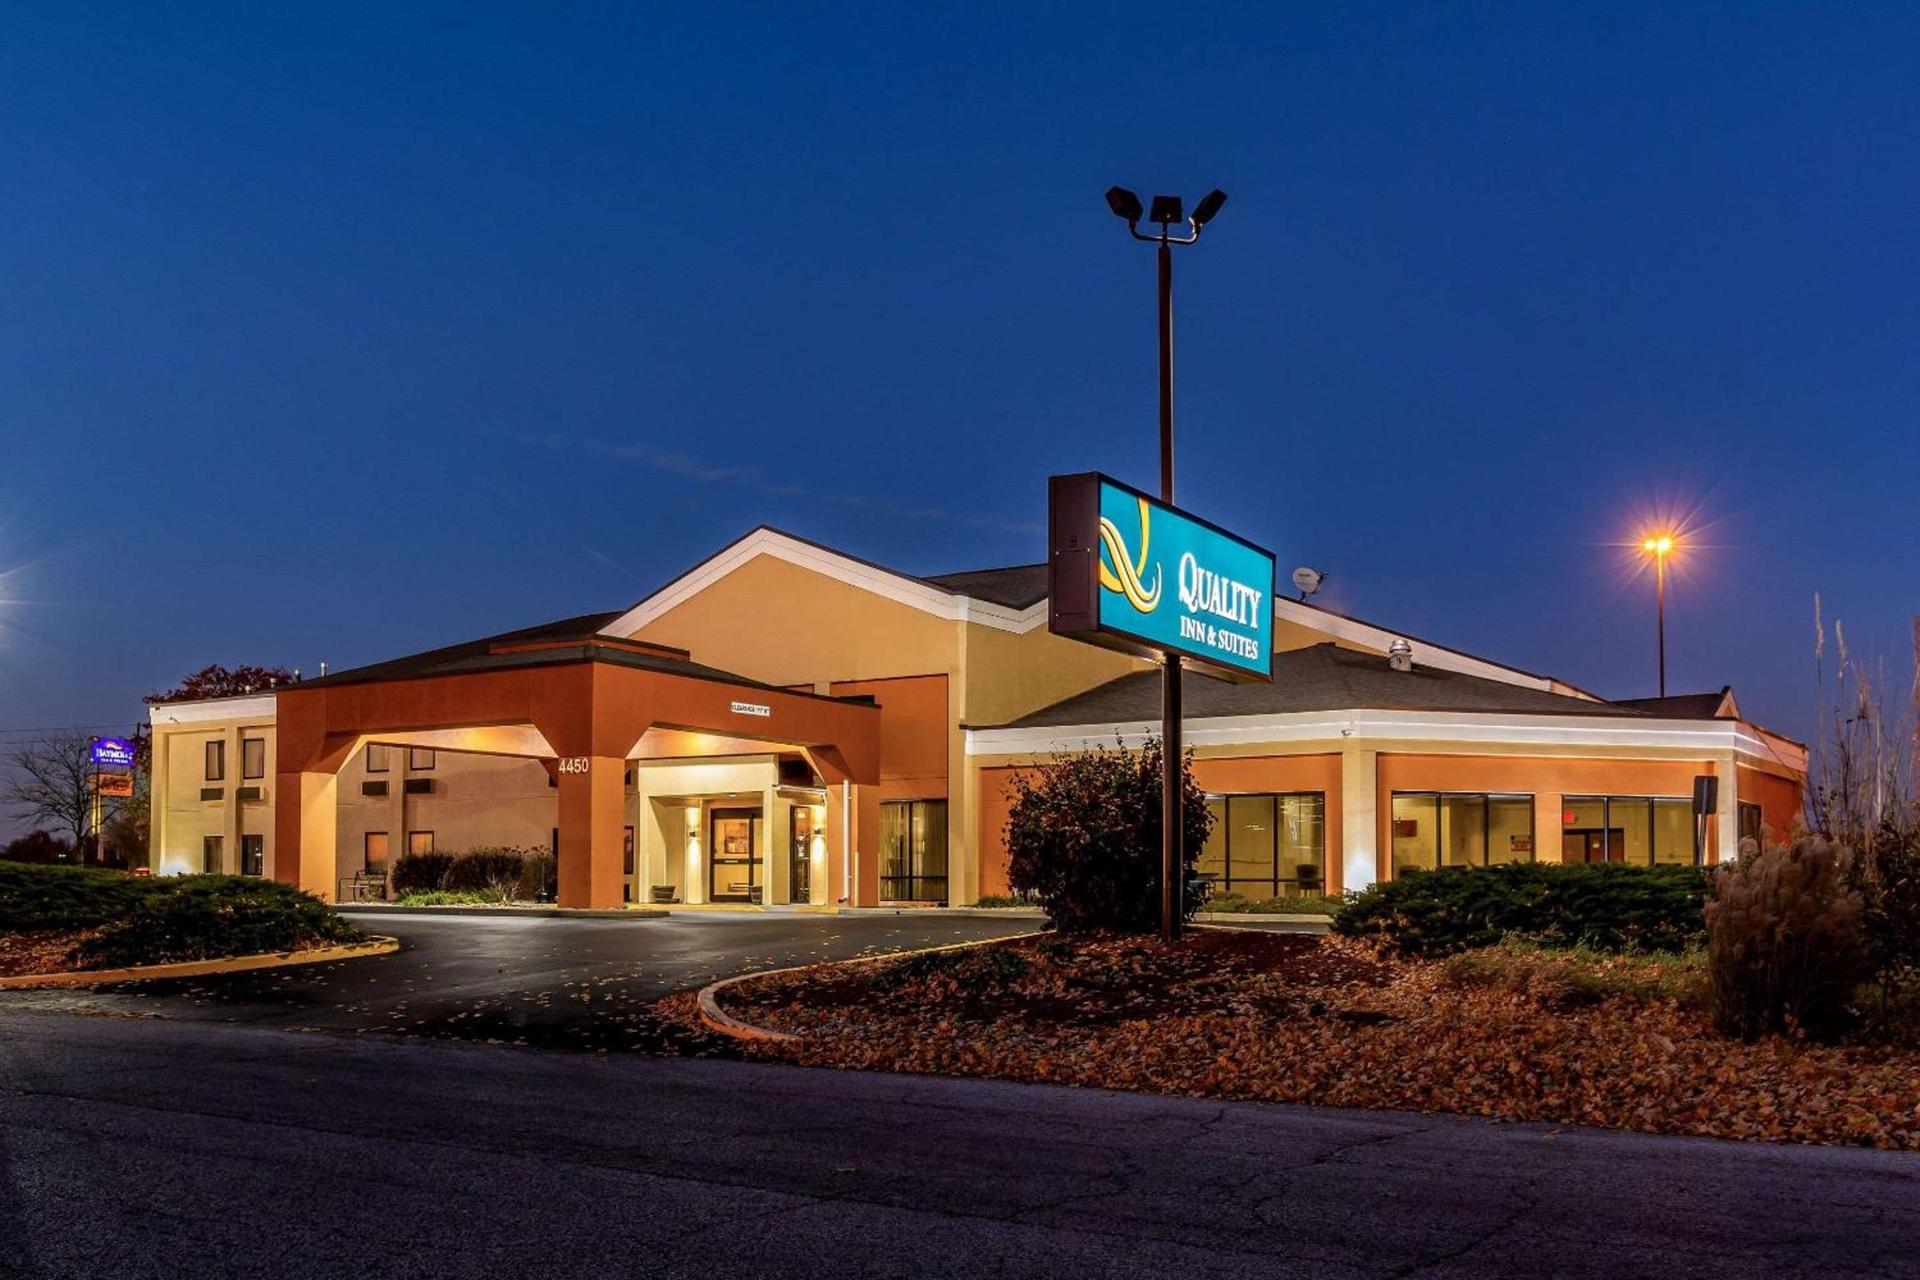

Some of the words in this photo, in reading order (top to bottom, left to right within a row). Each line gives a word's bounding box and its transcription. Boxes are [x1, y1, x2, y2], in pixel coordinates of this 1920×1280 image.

[1179, 552, 1262, 629] QUALITY
[1180, 615, 1206, 643] INN
[1207, 625, 1216, 647] &
[1218, 629, 1258, 660] SUITES
[559, 757, 589, 774] 4450
